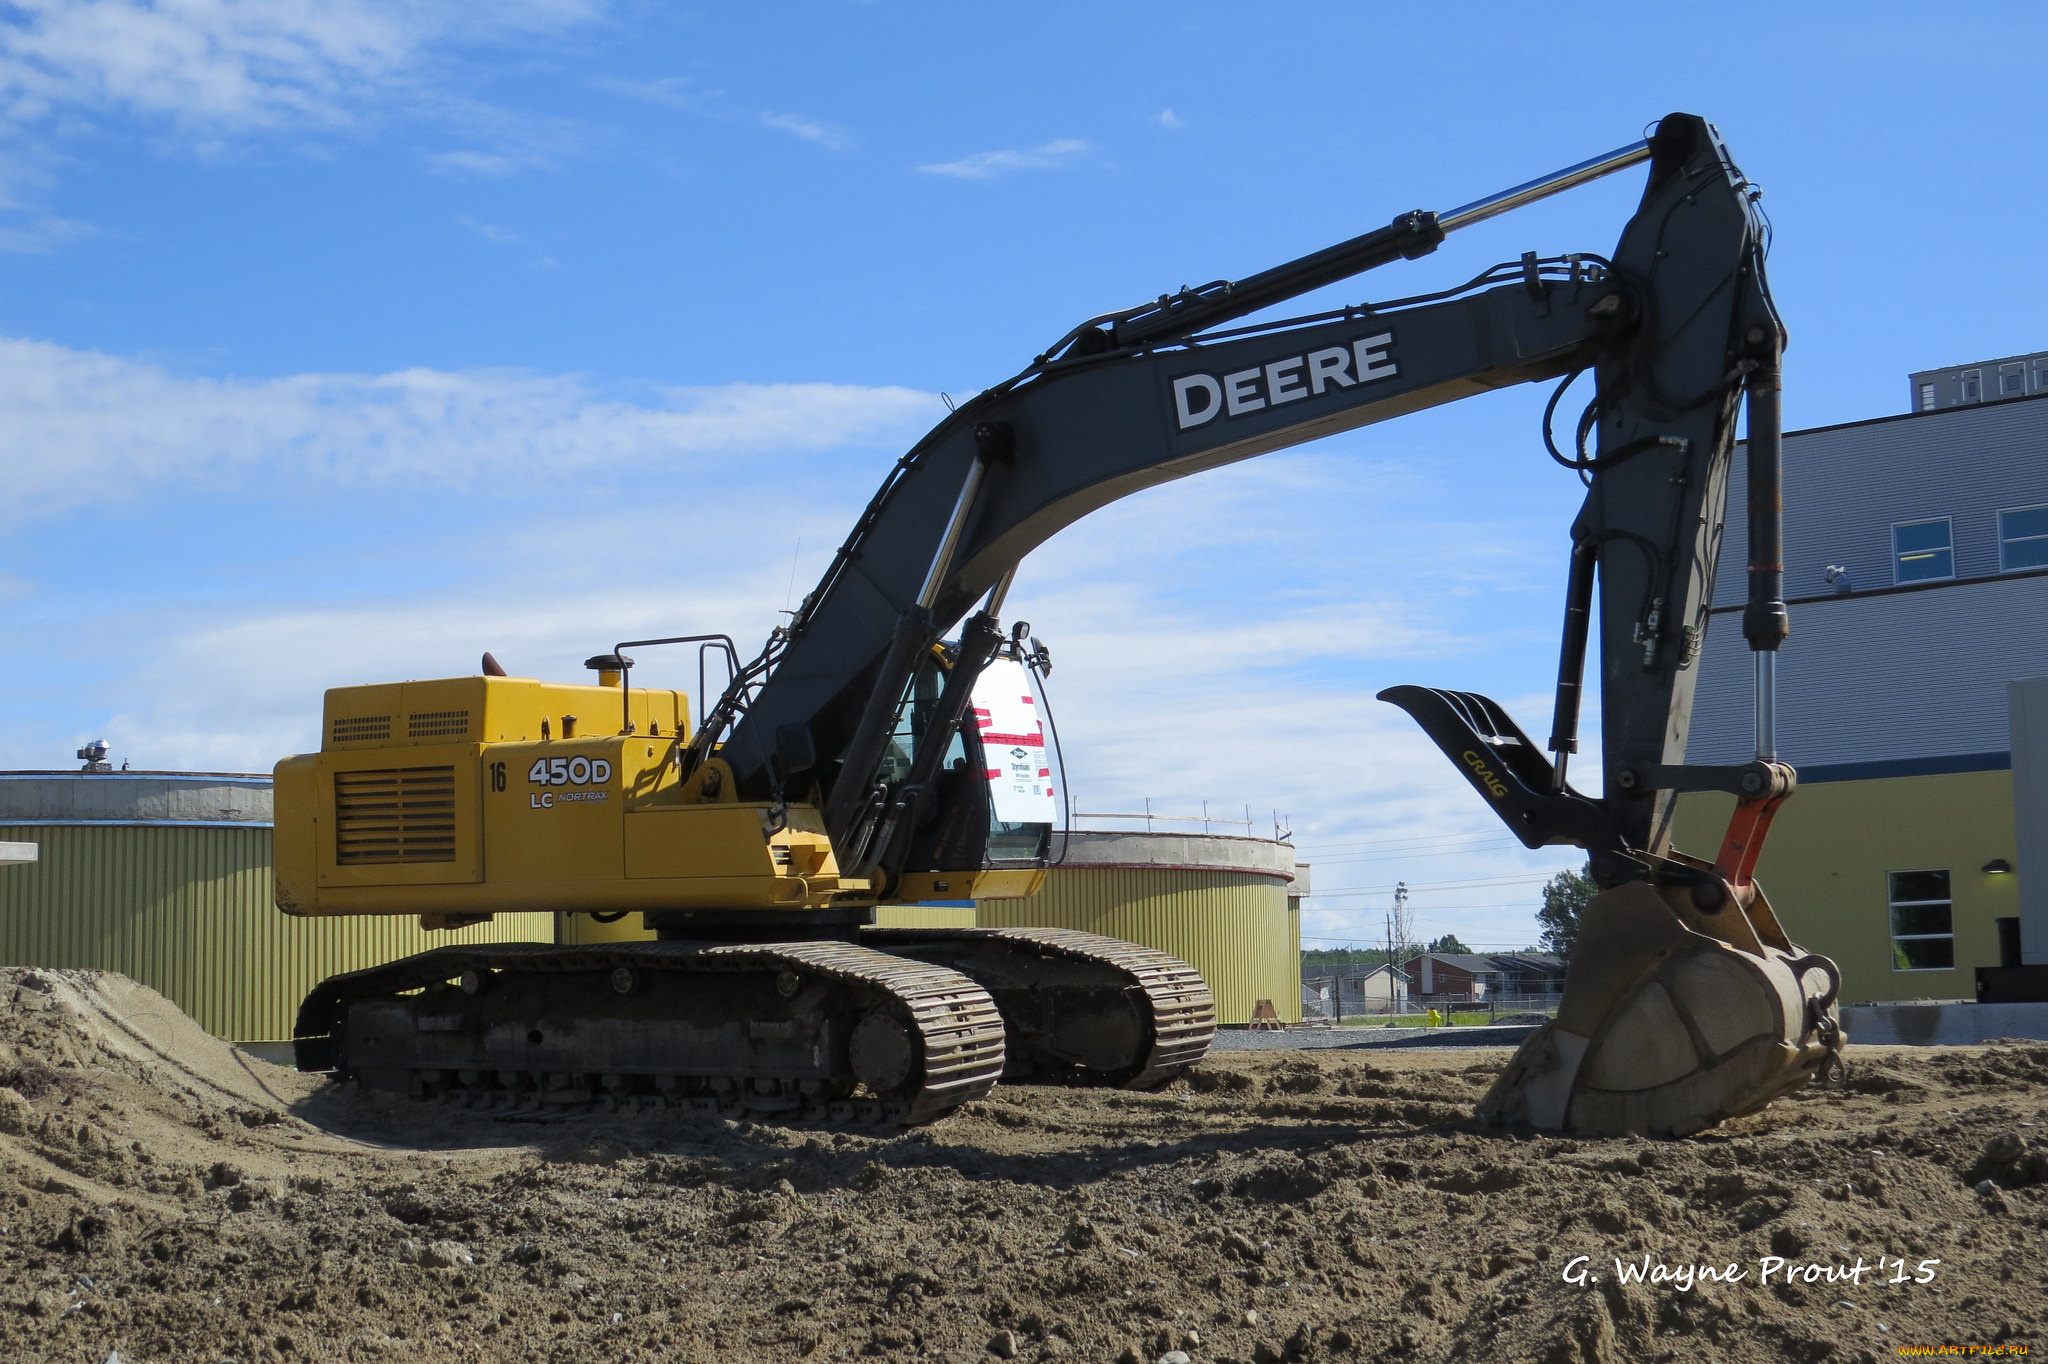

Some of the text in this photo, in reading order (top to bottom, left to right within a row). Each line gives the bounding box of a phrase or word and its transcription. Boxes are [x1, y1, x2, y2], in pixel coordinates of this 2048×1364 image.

[1172, 331, 1398, 430] DEERE
[489, 761, 507, 792] 16
[528, 755, 612, 786] 450D
[1463, 750, 1509, 797] CRAIG
[530, 791, 609, 809] LC NORTRAX
